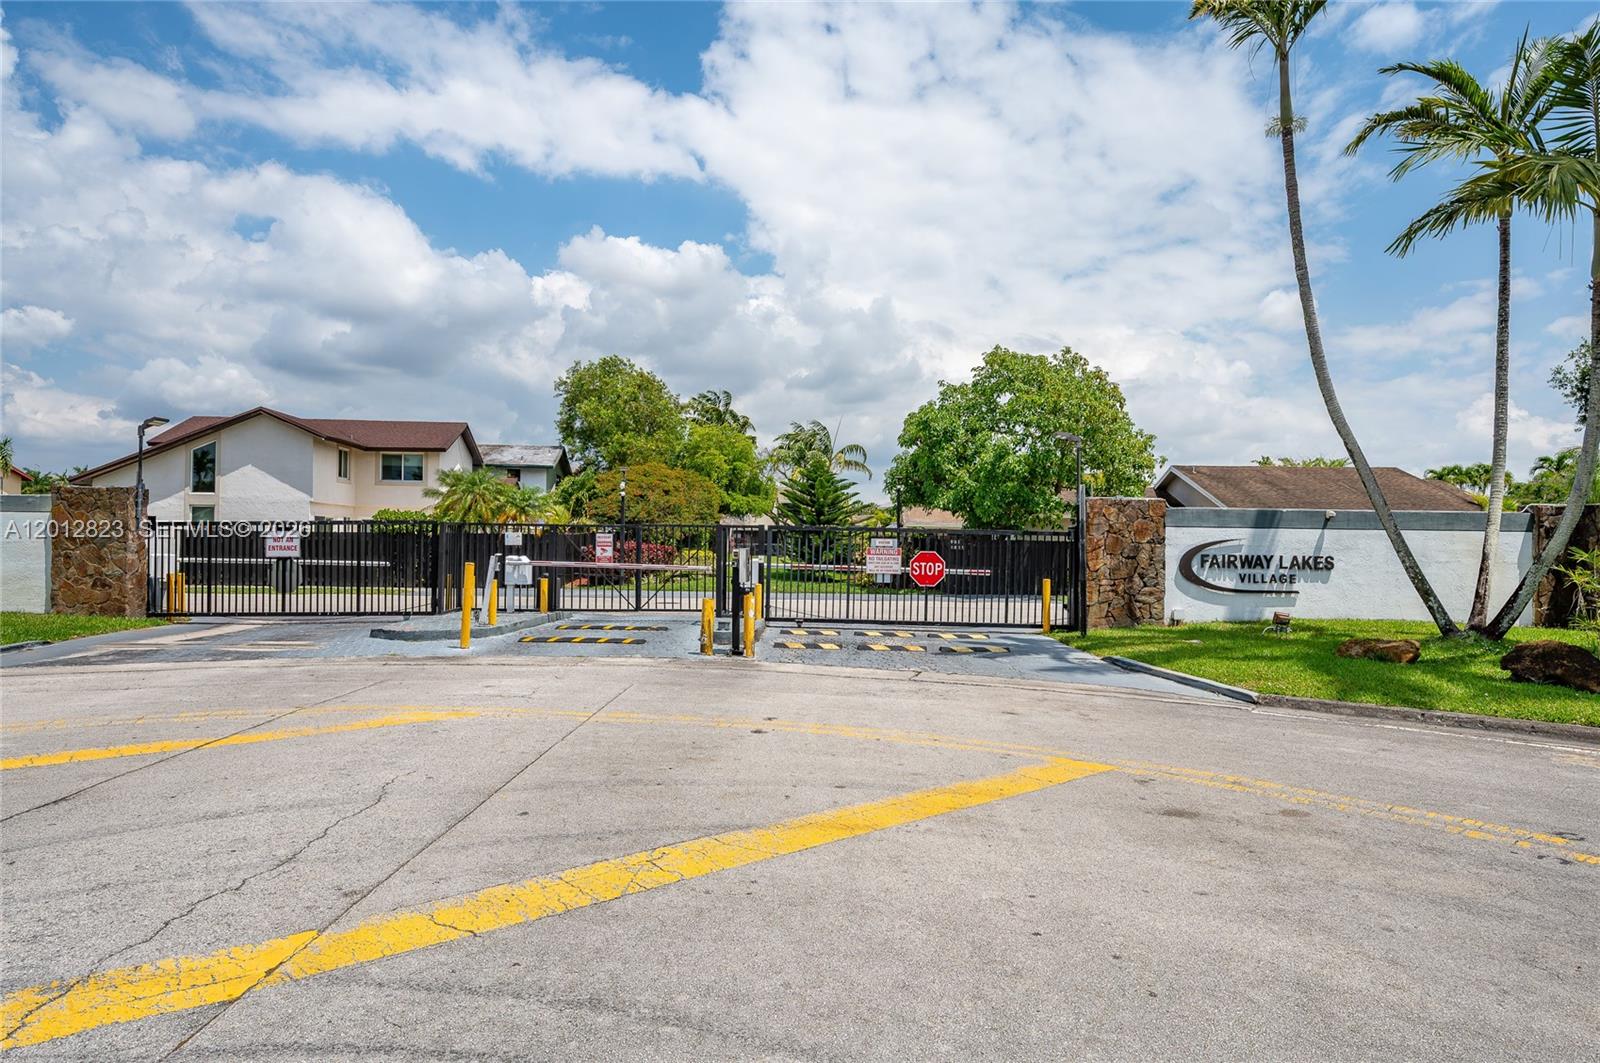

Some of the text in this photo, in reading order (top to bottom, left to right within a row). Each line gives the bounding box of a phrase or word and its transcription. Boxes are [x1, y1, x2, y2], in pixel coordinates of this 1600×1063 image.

[870, 547, 899, 556] WARNING
[912, 562, 943, 576] STOP
[1200, 554, 1335, 571] FAIRWAY LAKES
[1239, 573, 1297, 585] VILLAGE
